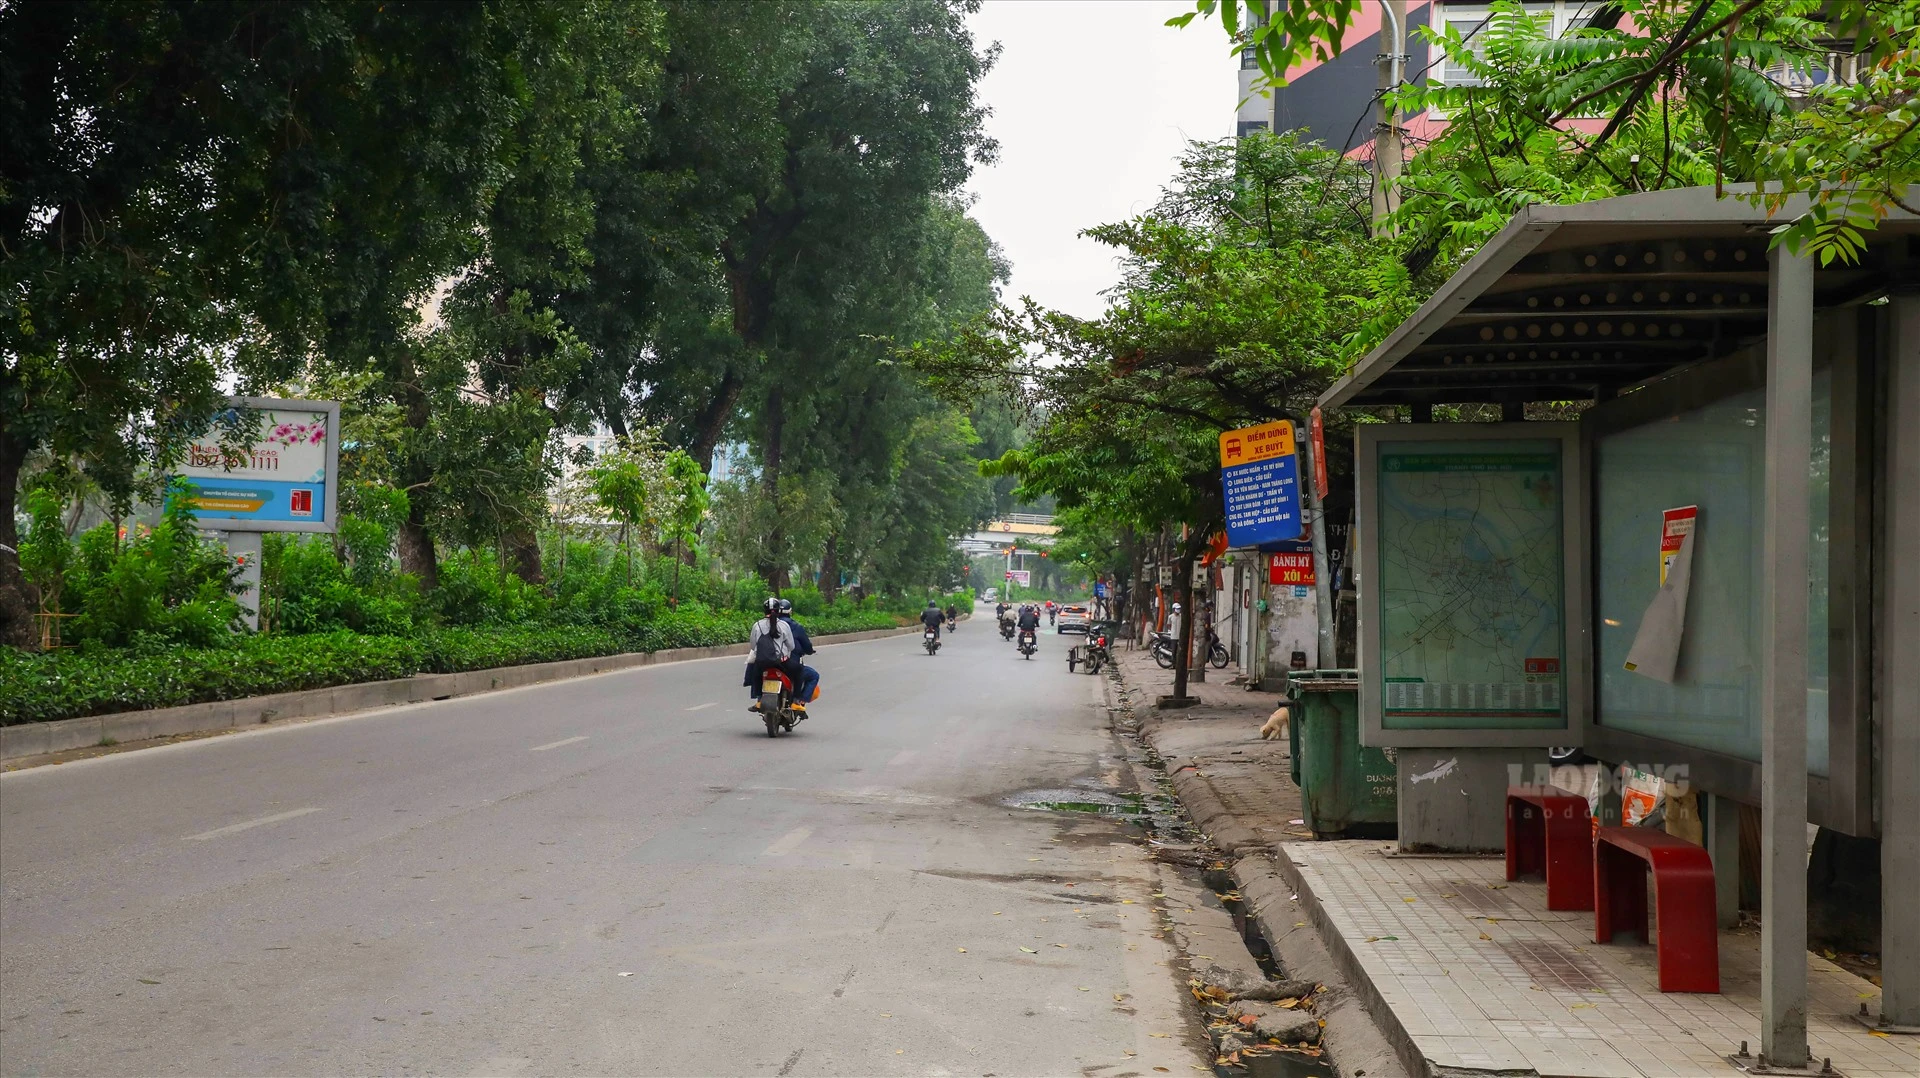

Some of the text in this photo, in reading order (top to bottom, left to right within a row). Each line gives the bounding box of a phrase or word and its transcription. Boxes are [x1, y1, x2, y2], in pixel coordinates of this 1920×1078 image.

[1247, 428, 1288, 442] ĐIỂM DỪNG
[1254, 440, 1283, 454] XE BUÝT
[1283, 568, 1301, 581] XÔI
